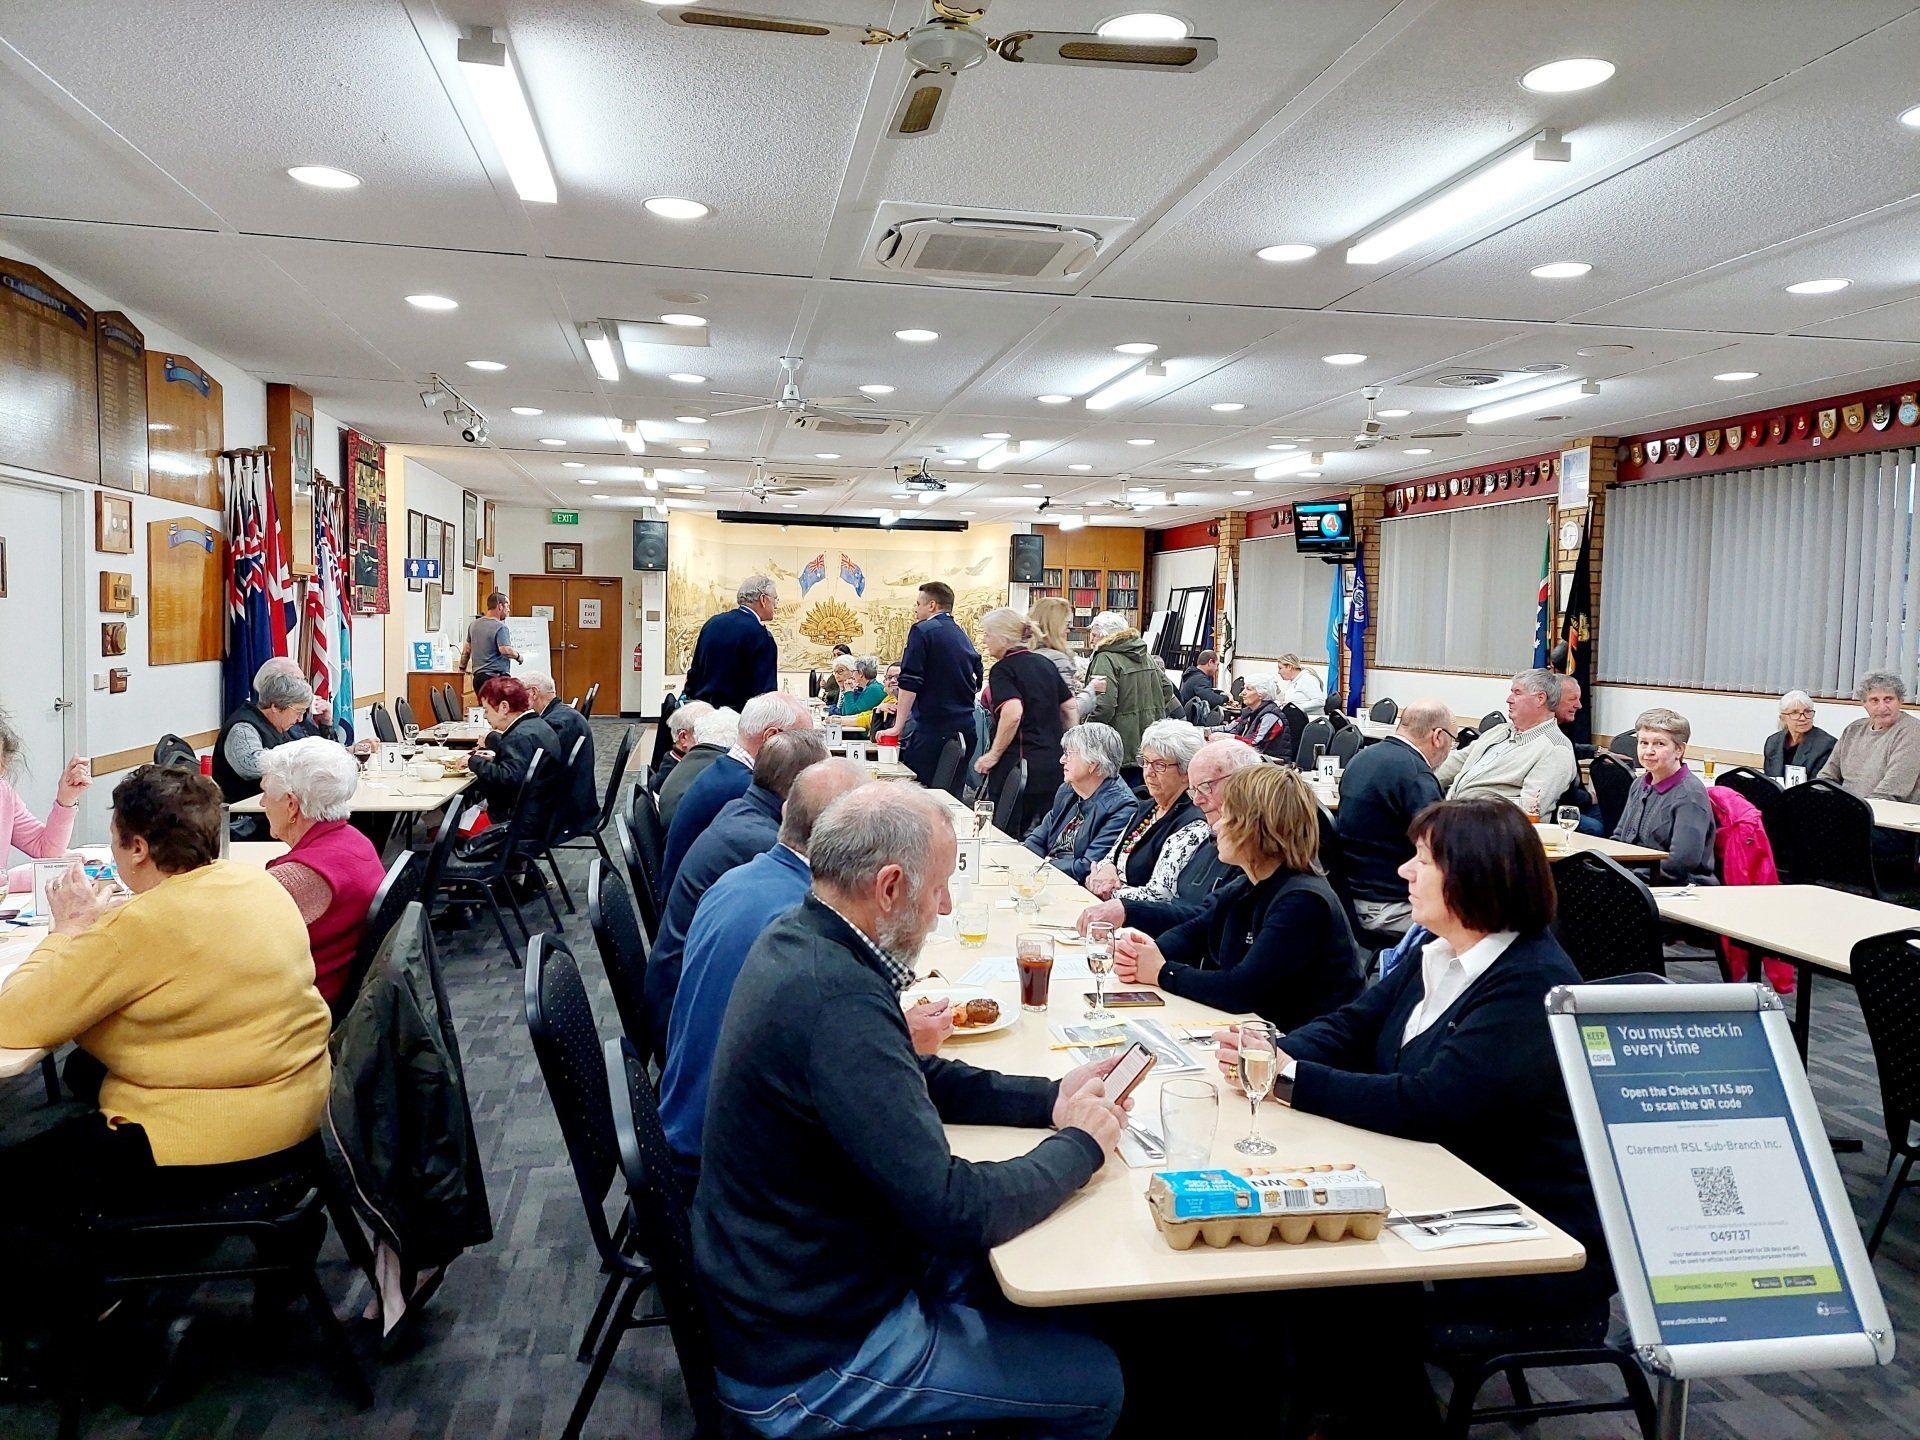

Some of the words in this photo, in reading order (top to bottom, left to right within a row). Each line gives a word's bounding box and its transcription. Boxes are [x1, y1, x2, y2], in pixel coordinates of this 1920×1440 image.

[557, 514, 573, 522] EXIT
[474, 714, 479, 723] 2
[389, 752, 394, 763] 3
[853, 750, 859, 760] 6
[1324, 765, 1333, 776] 13
[1791, 775, 1800, 786] 18
[958, 853, 966, 871] 5
[1587, 1032, 1605, 1040] KEEP
[1617, 1026, 1646, 1040] You
[1649, 1026, 1684, 1039] must
[1687, 1024, 1726, 1038] check
[1729, 1023, 1742, 1037] in
[1623, 1042, 1664, 1057] every
[1666, 1041, 1700, 1055] time
[1593, 1054, 1612, 1062] COVID
[1621, 1087, 1649, 1099] Open
[1650, 1086, 1667, 1097] the
[1668, 1085, 1699, 1097] Check
[1712, 1084, 1733, 1094] TAS
[1735, 1084, 1753, 1096] app
[1641, 1102, 1653, 1112] to
[1655, 1101, 1679, 1111] scan
[1681, 1099, 1698, 1110] the
[1700, 1099, 1716, 1110] QR
[1718, 1098, 1742, 1109] code
[1626, 1144, 1678, 1155] Claremont
[1681, 1142, 1703, 1153] RSL
[1704, 1140, 1761, 1151] Sub-Branch
[1763, 1139, 1782, 1149] Inc.
[1710, 1229, 1751, 1242] 049737
